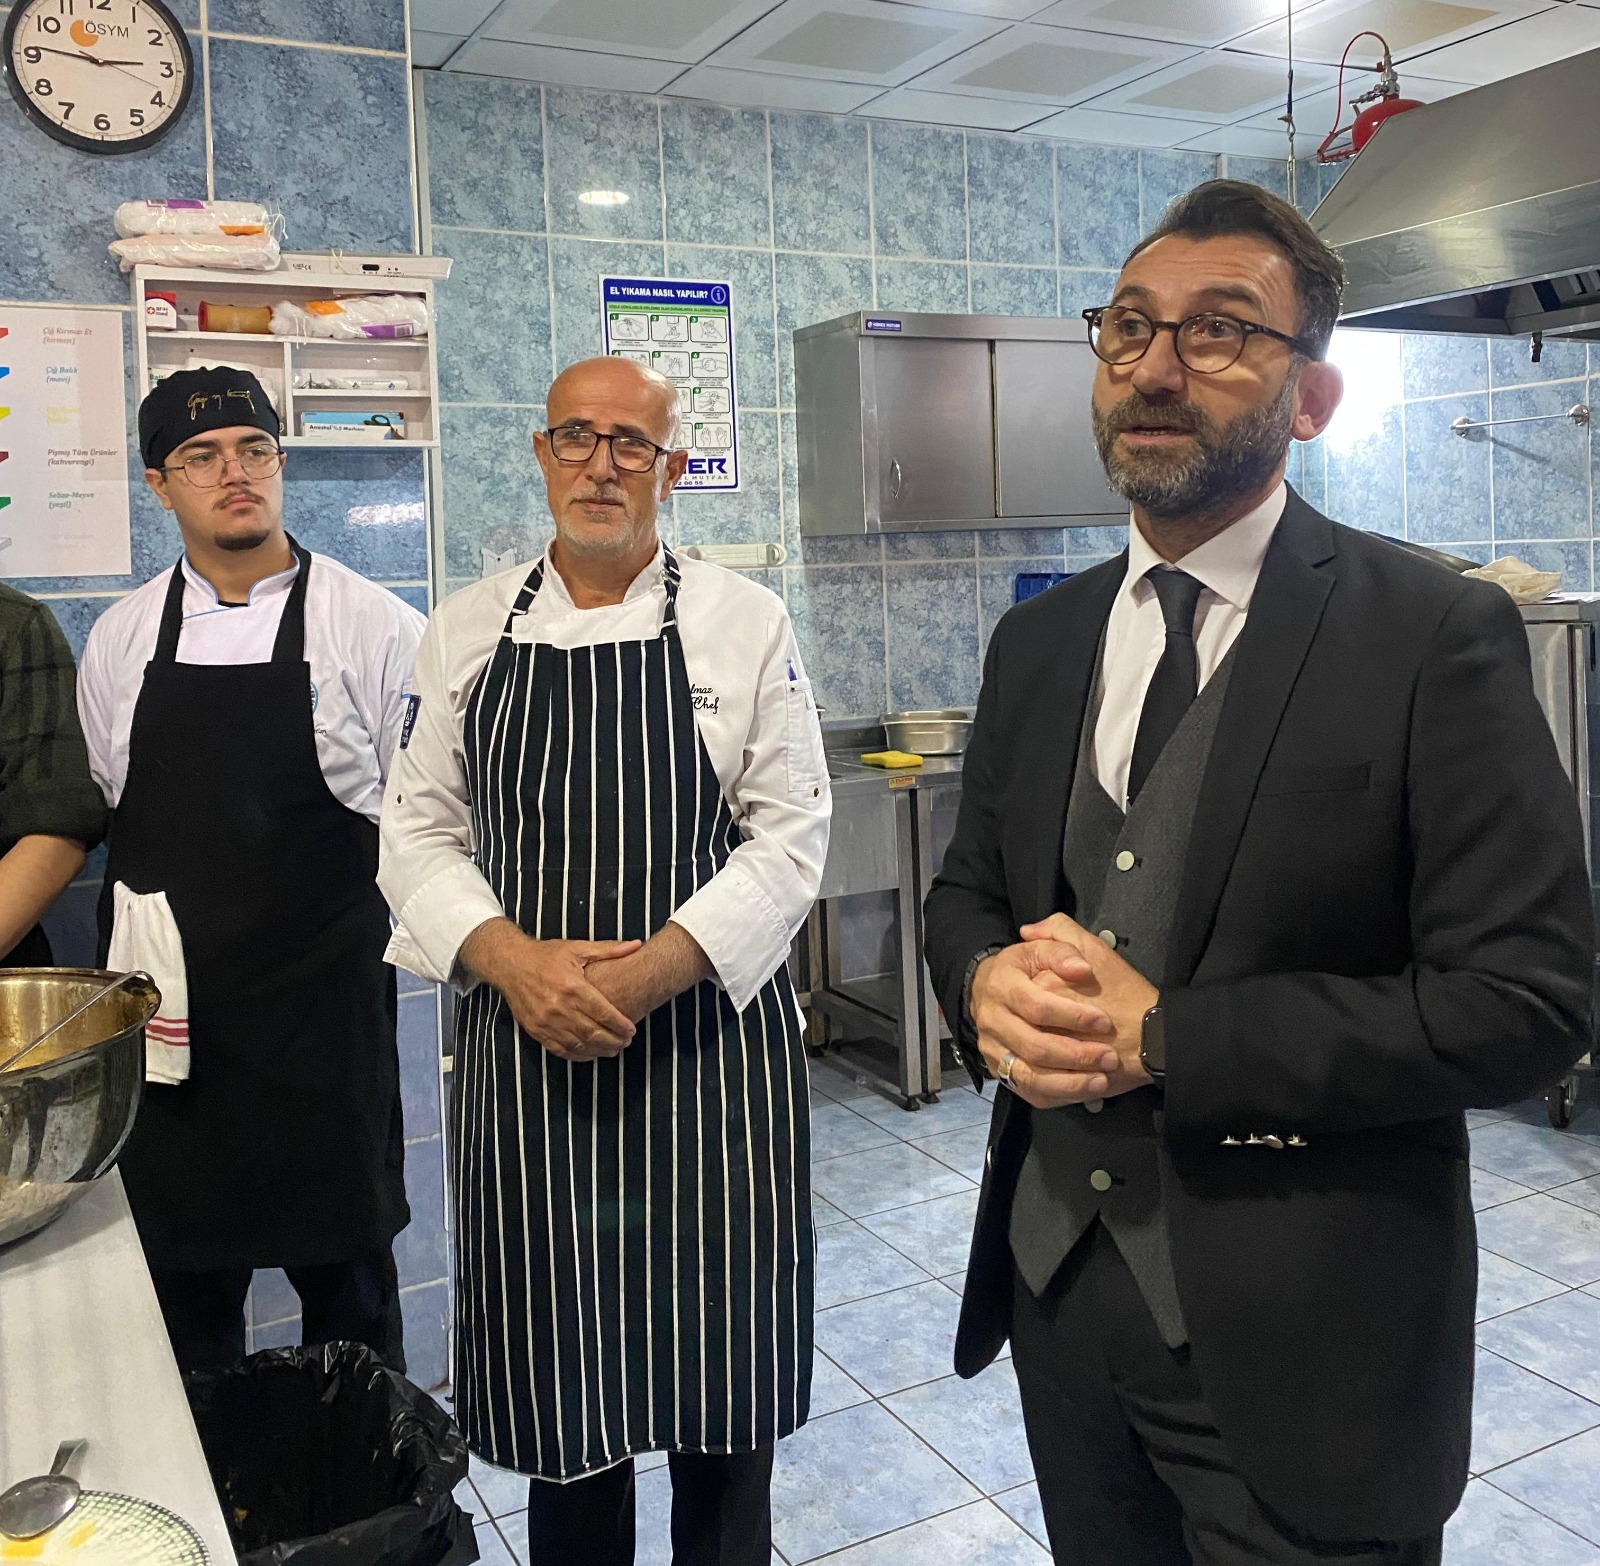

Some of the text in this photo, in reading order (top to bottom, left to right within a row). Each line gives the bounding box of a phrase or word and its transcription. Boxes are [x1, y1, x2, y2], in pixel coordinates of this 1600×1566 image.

[60, 0, 74, 15] 11
[132, 6, 136, 23] 1
[37, 15, 61, 34] 10
[85, 20, 129, 38] ÖSYM
[147, 29, 164, 46] 2
[23, 46, 42, 64] 9
[160, 61, 174, 78] 3
[34, 78, 53, 96] 8
[150, 90, 166, 108] 4
[58, 101, 75, 120] 7
[130, 108, 145, 126] 5
[93, 113, 111, 131] 6
[609, 286, 708, 299] EL YIKAMA NASIL YAPILIR?
[84, 328, 93, 336] Et
[90, 448, 118, 456] Ürünler
[48, 459, 95, 467] (kahverengi)
[683, 458, 728, 474] ER
[692, 695, 720, 714] Chef
